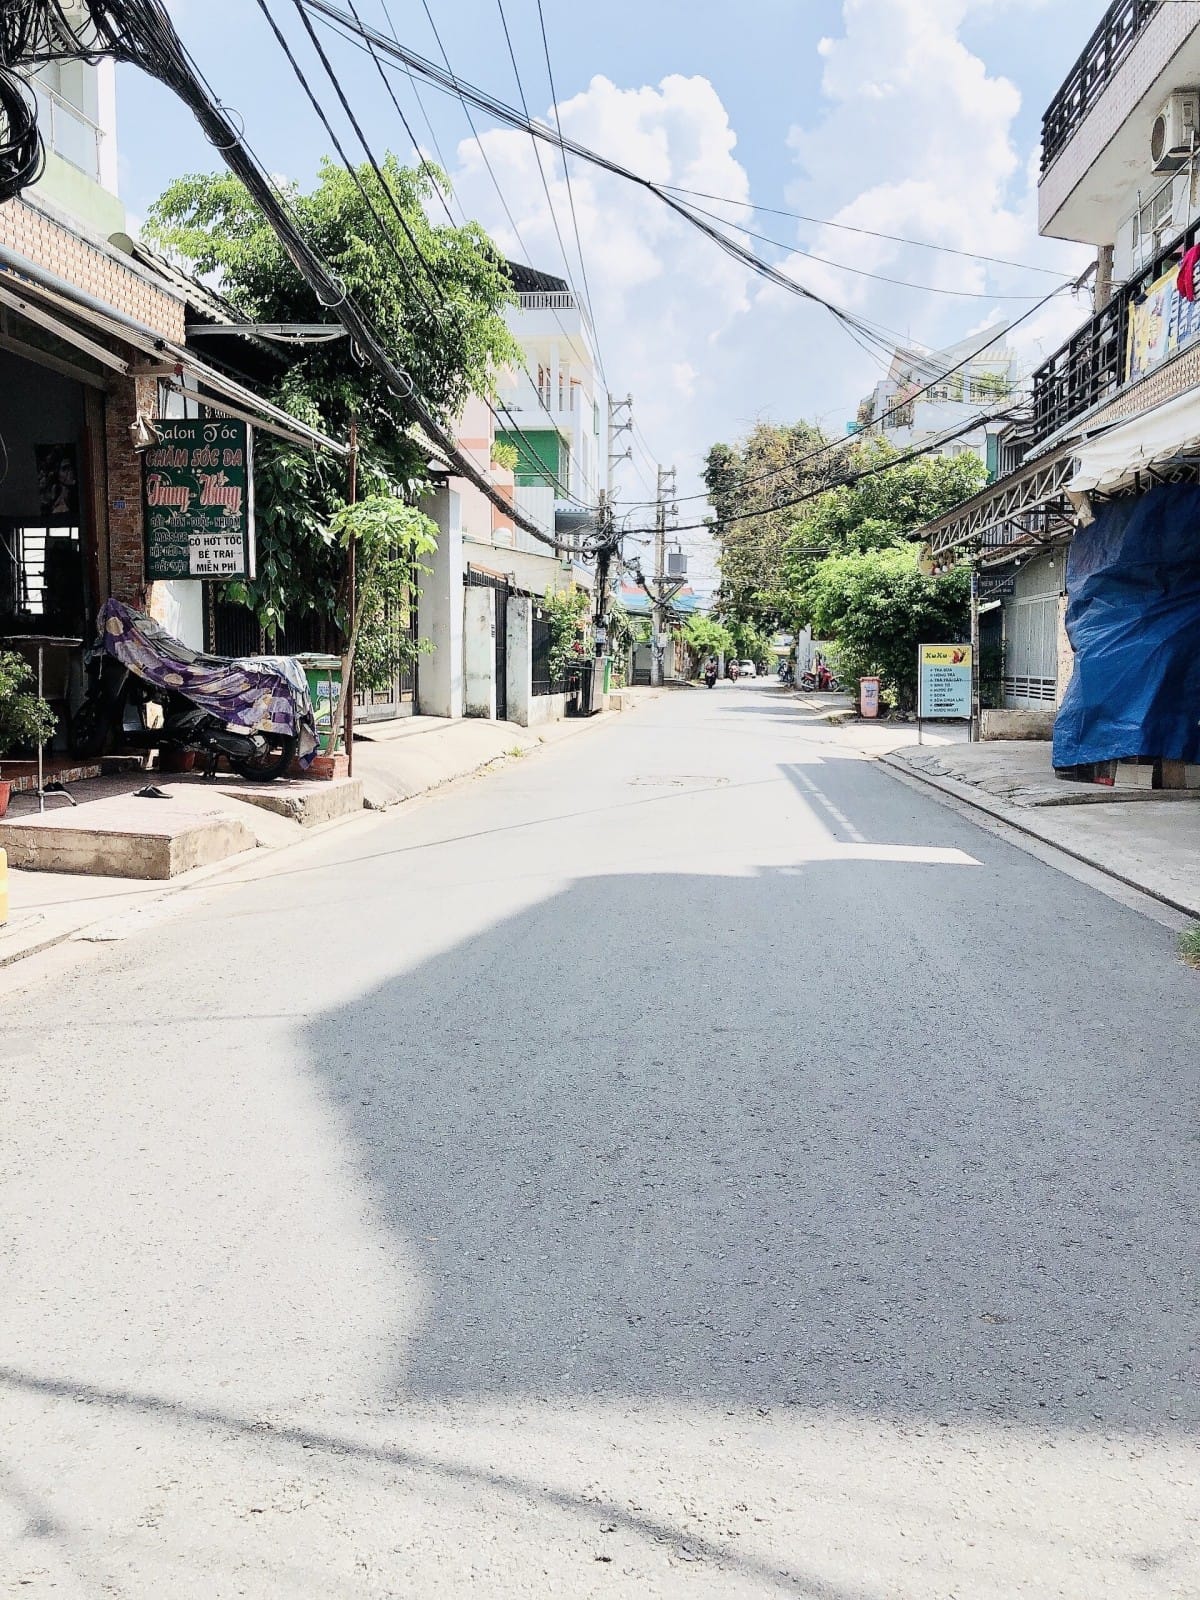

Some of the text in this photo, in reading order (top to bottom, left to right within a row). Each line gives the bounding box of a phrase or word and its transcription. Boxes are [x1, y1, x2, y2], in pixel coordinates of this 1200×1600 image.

[152, 422, 238, 445] Salon Tóc
[145, 444, 189, 468] CHĂM
[191, 443, 220, 467] SÓC
[225, 534, 242, 545] TÓC
[213, 549, 234, 559] TRAI
[196, 560, 237, 573] MIỄN PHÍ
